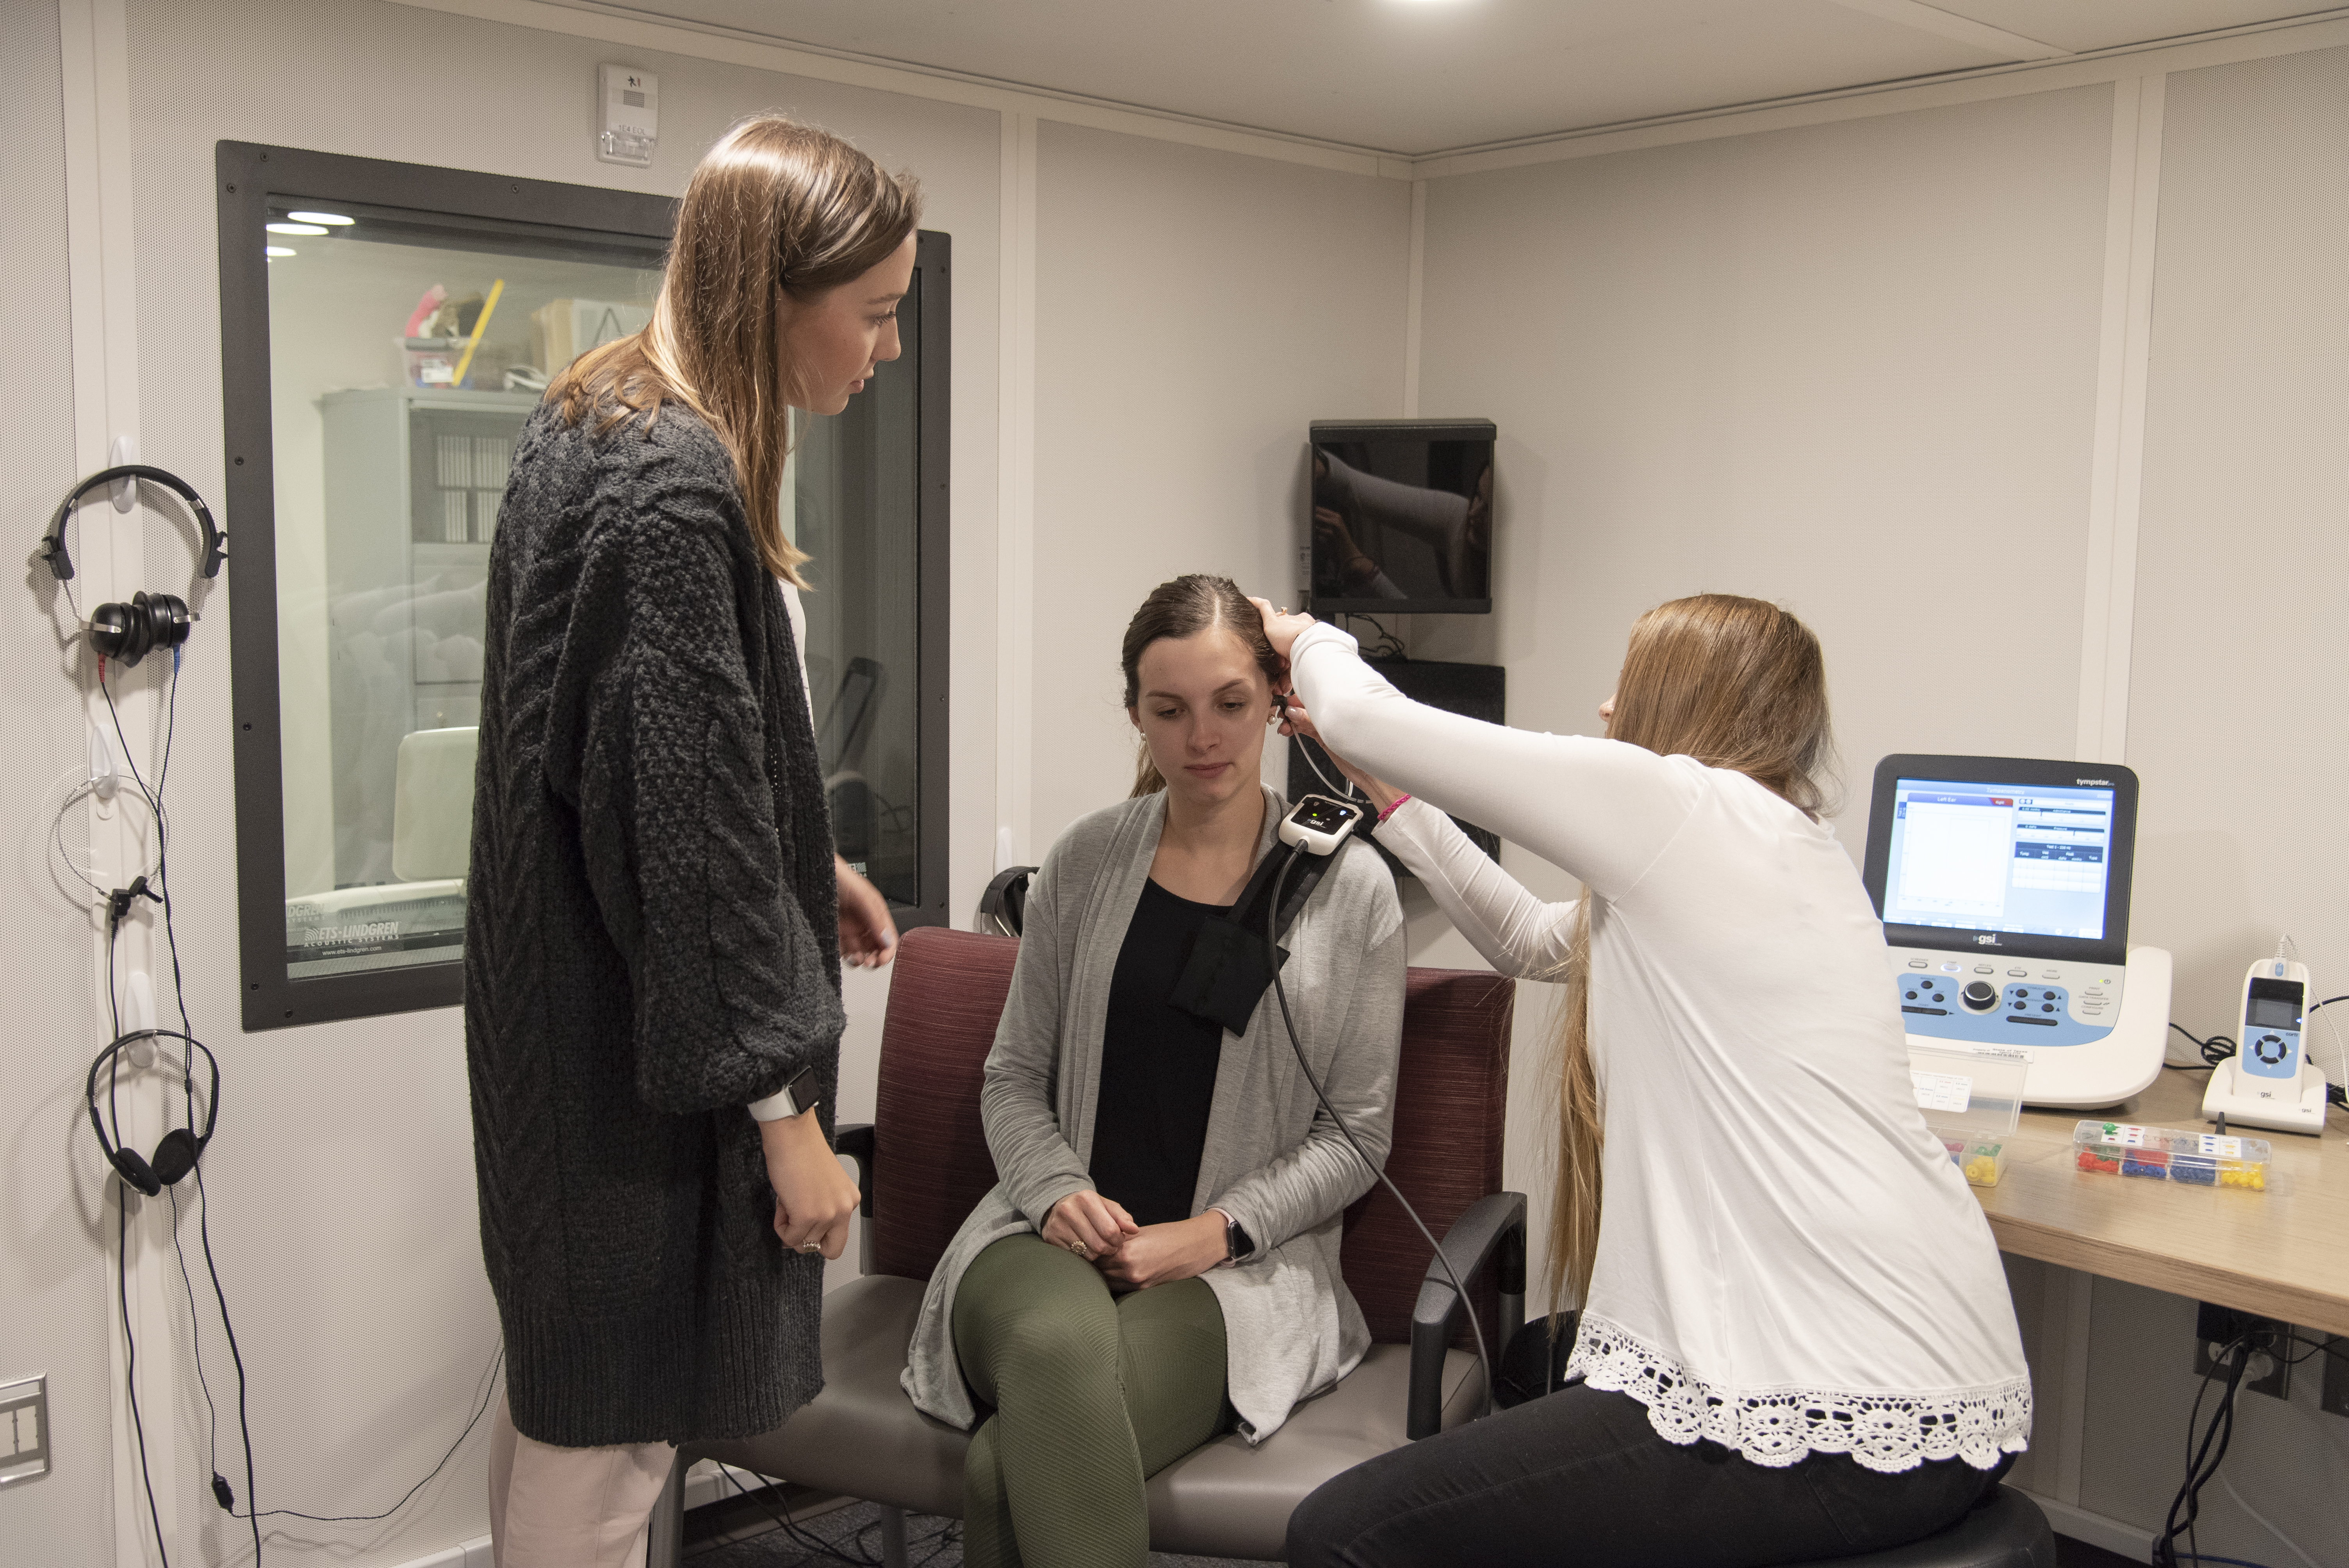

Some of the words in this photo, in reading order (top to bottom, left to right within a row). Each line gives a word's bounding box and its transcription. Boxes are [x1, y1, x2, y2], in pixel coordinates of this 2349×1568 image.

[1986, 787, 2025, 795] Tympanometry
[358, 934, 399, 943] SYSTEMS
[1978, 934, 1996, 944] gsi
[322, 946, 382, 955] www.ets-lindgren.com
